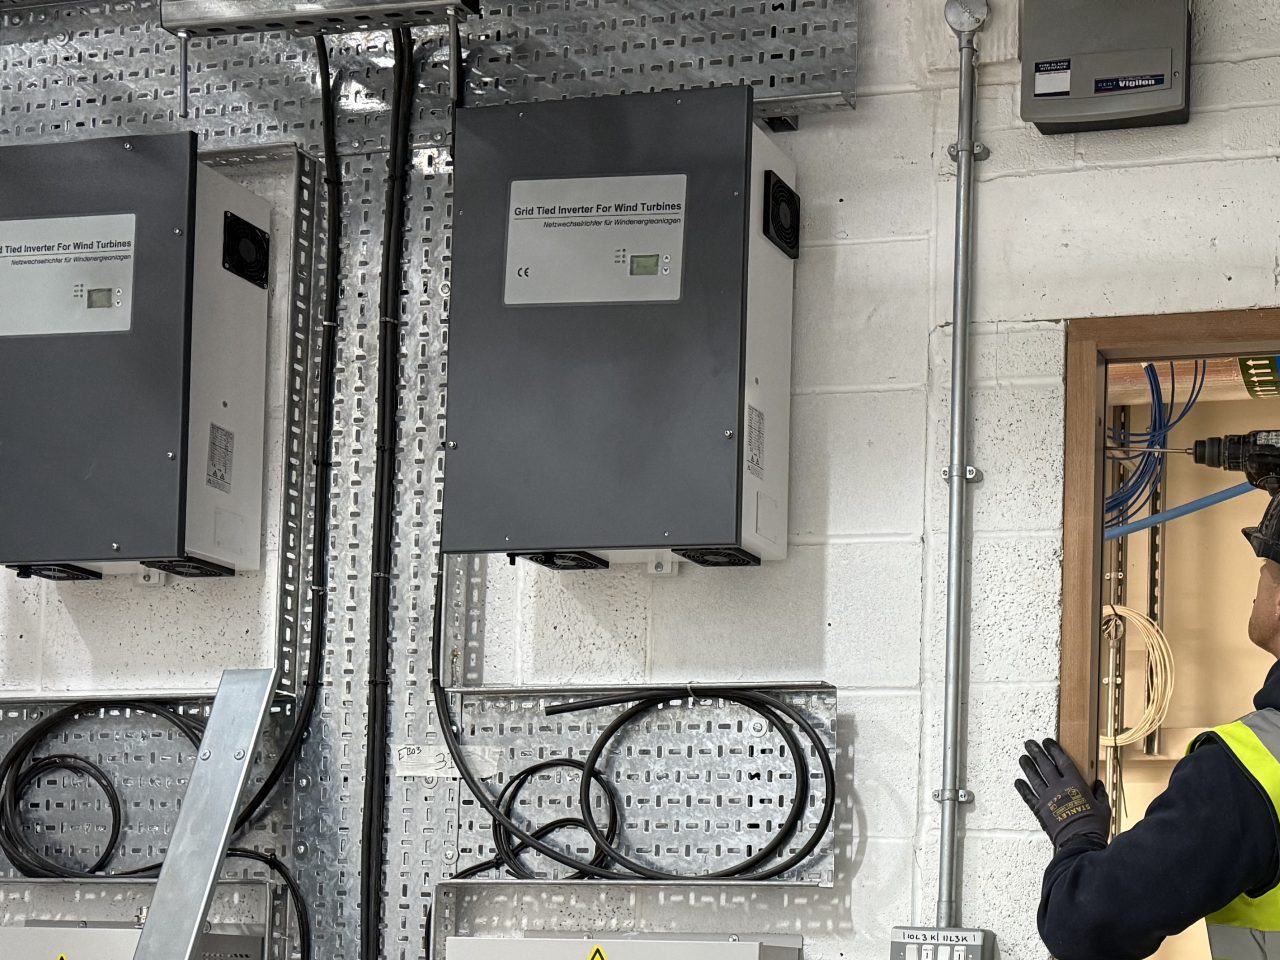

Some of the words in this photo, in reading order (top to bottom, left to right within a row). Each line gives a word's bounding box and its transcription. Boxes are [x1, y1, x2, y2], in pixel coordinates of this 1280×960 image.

[1118, 79, 1156, 87] Vigilon
[514, 206, 534, 216] Grid
[536, 205, 556, 215] Tied
[558, 204, 594, 215] Inverter
[596, 204, 612, 213] For
[614, 202, 638, 212] Wind
[640, 201, 682, 212] Turbines
[5, 245, 22, 254] Tied
[23, 243, 55, 253] Inverter
[56, 242, 72, 251] For
[72, 241, 94, 250] Wind
[95, 240, 132, 249] Turbines
[1056, 803, 1091, 822] STANLEY
